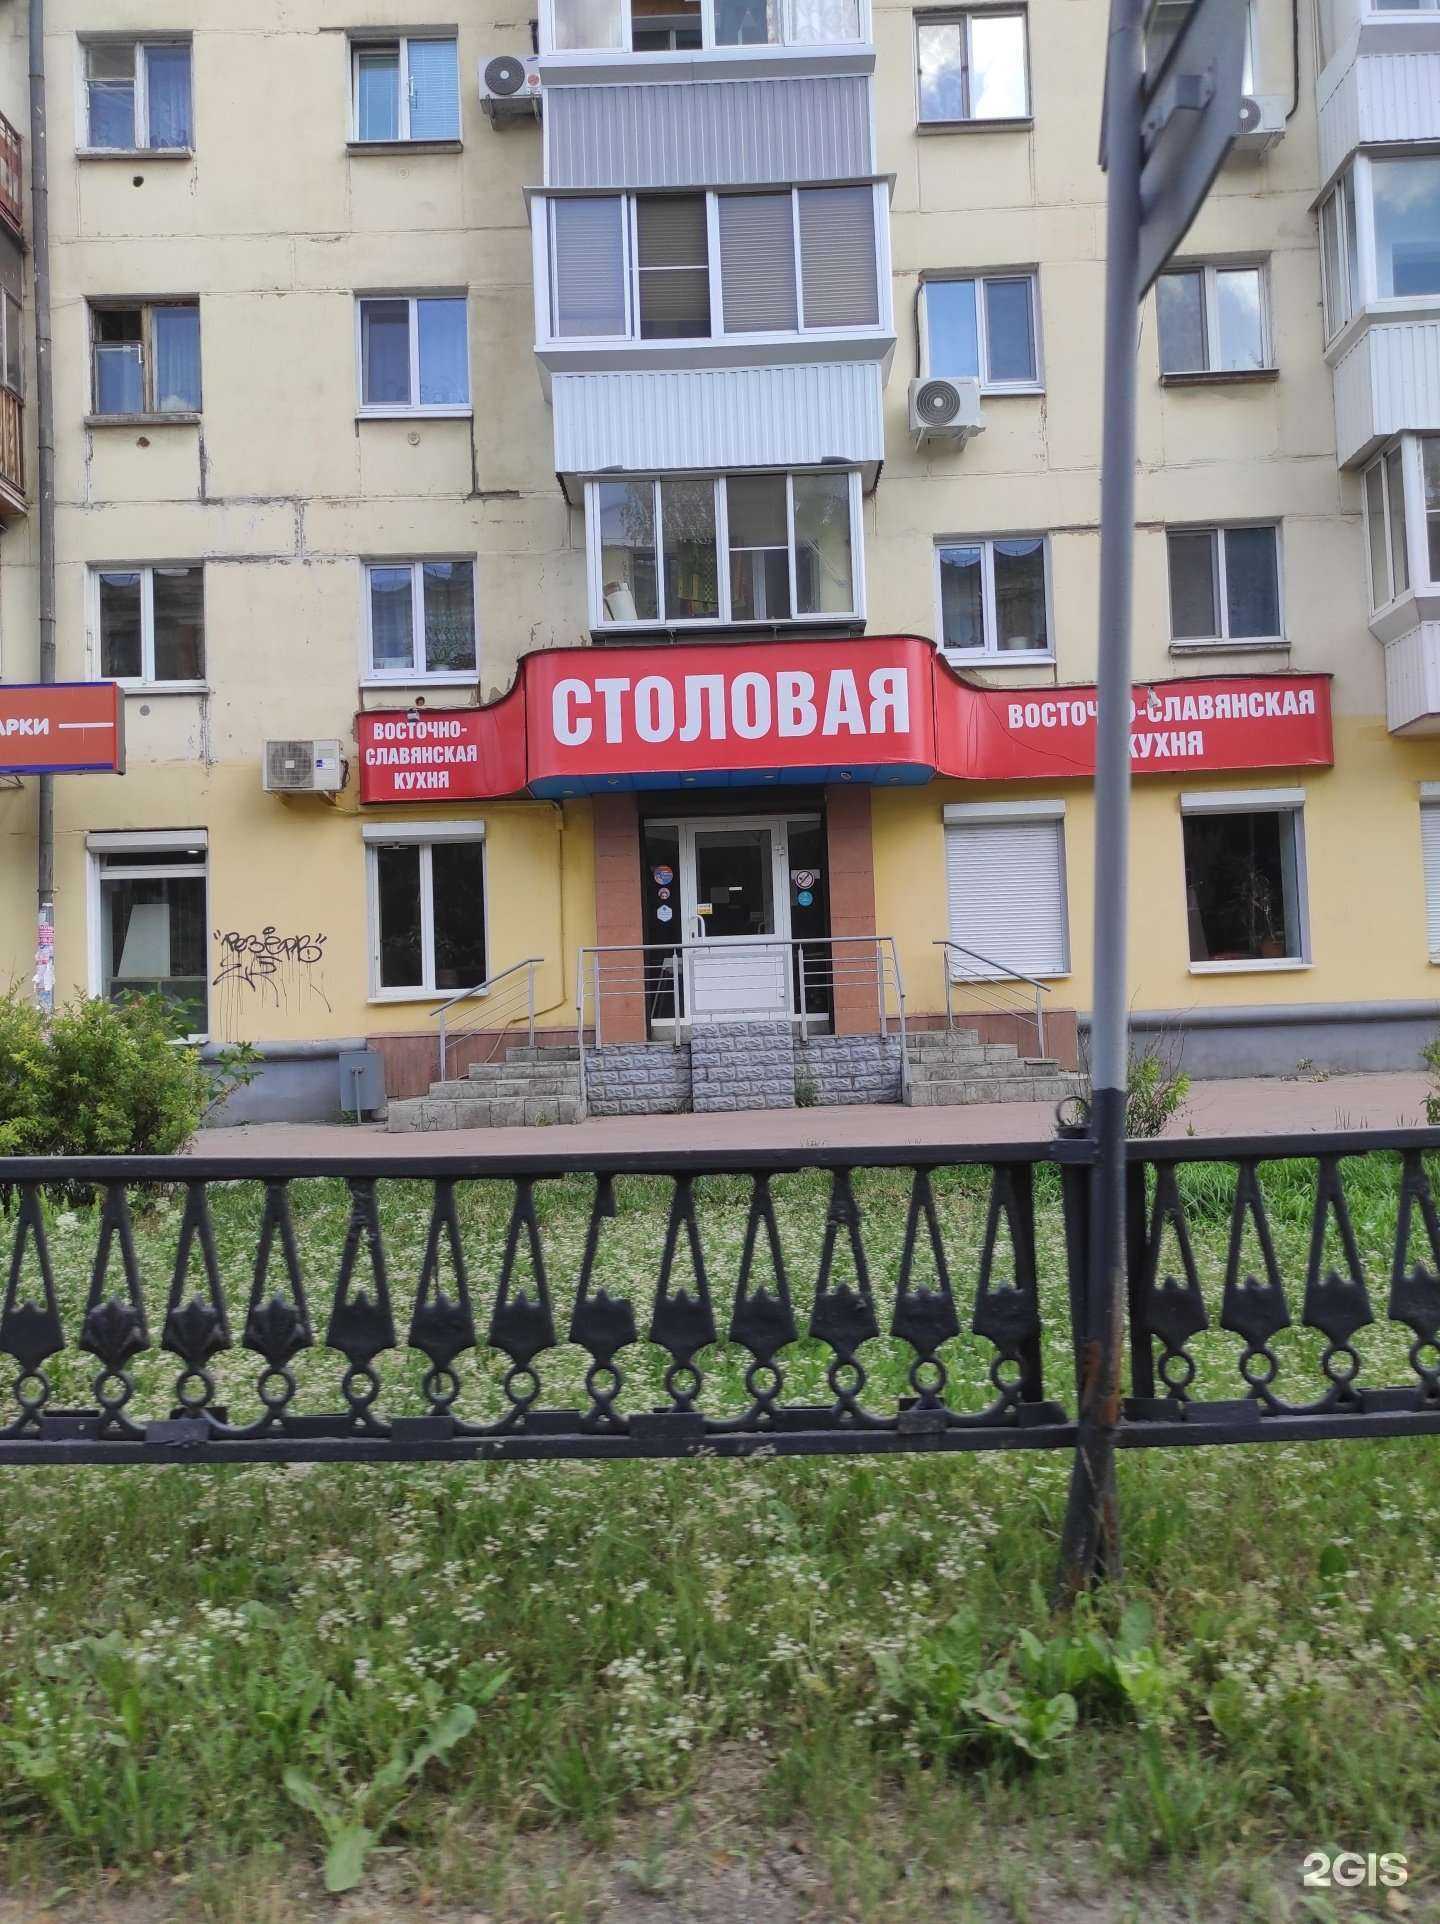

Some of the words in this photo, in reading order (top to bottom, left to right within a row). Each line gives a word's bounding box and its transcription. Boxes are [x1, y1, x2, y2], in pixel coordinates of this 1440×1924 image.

[551, 667, 911, 747] СТОЛОВАЯ
[1007, 690, 1315, 729] ВОСТОЧ-СЛАВЯНСКАЯ
[373, 721, 467, 740] ВОСТОЧНО-
[366, 745, 477, 766] СЛАВЯНСКАЯ
[394, 771, 450, 790] КУХНЯ
